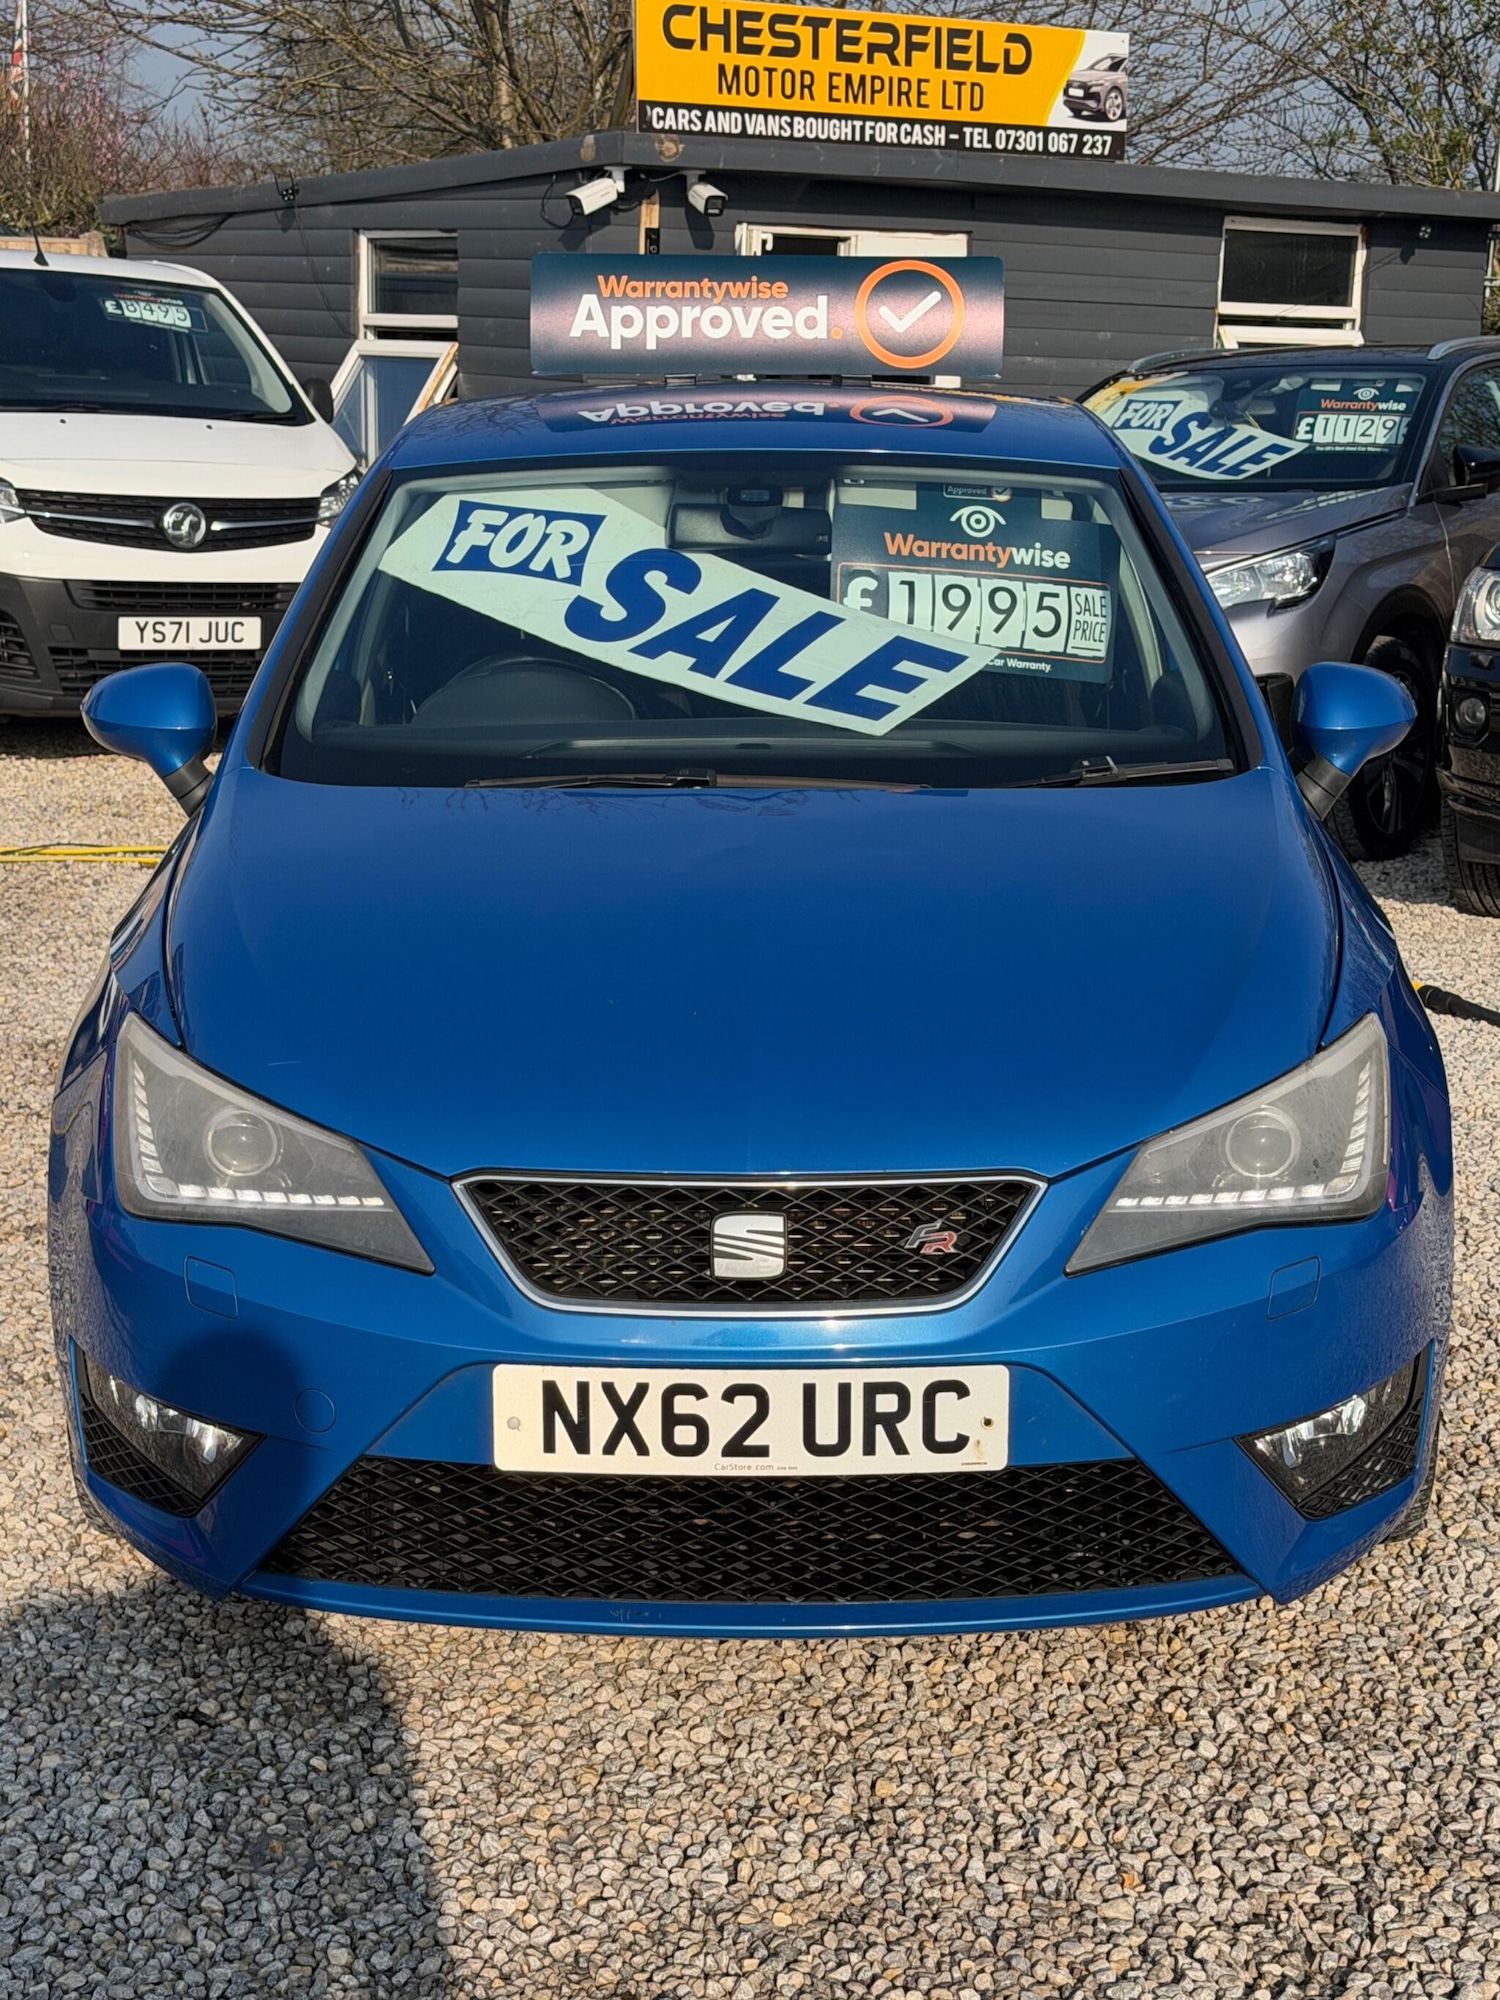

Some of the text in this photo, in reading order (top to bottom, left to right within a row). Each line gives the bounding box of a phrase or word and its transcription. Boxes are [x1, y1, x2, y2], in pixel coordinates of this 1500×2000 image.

[663, 4, 1032, 75] CHESTERFIELD
[718, 63, 984, 111] MOTOR EMPIRE LTD
[704, 111, 742, 135] AND
[744, 113, 792, 138] VANS
[793, 116, 864, 142] BOUGHT
[864, 121, 898, 144] FOR
[900, 124, 946, 147] CASH
[963, 127, 992, 149] TEL
[995, 129, 1043, 152] 07301
[1048, 133, 1078, 154] 067
[1082, 134, 1112, 156] 237
[597, 275, 789, 304] Warrantywise
[1320, 399, 1407, 411] Warrantywise
[1114, 401, 1296, 477] FOR SALE
[947, 484, 987, 495] Approved
[883, 531, 1071, 570] Warrantywise
[446, 508, 970, 722] FOR SALE
[1075, 593, 1107, 618] SALE
[135, 621, 245, 643] YS71 JUC
[1073, 619, 1107, 643] PRICE
[904, 1221, 957, 1254] FR
[541, 1379, 971, 1458] NX62 URC
[714, 1463, 774, 1471] CarStore.com
